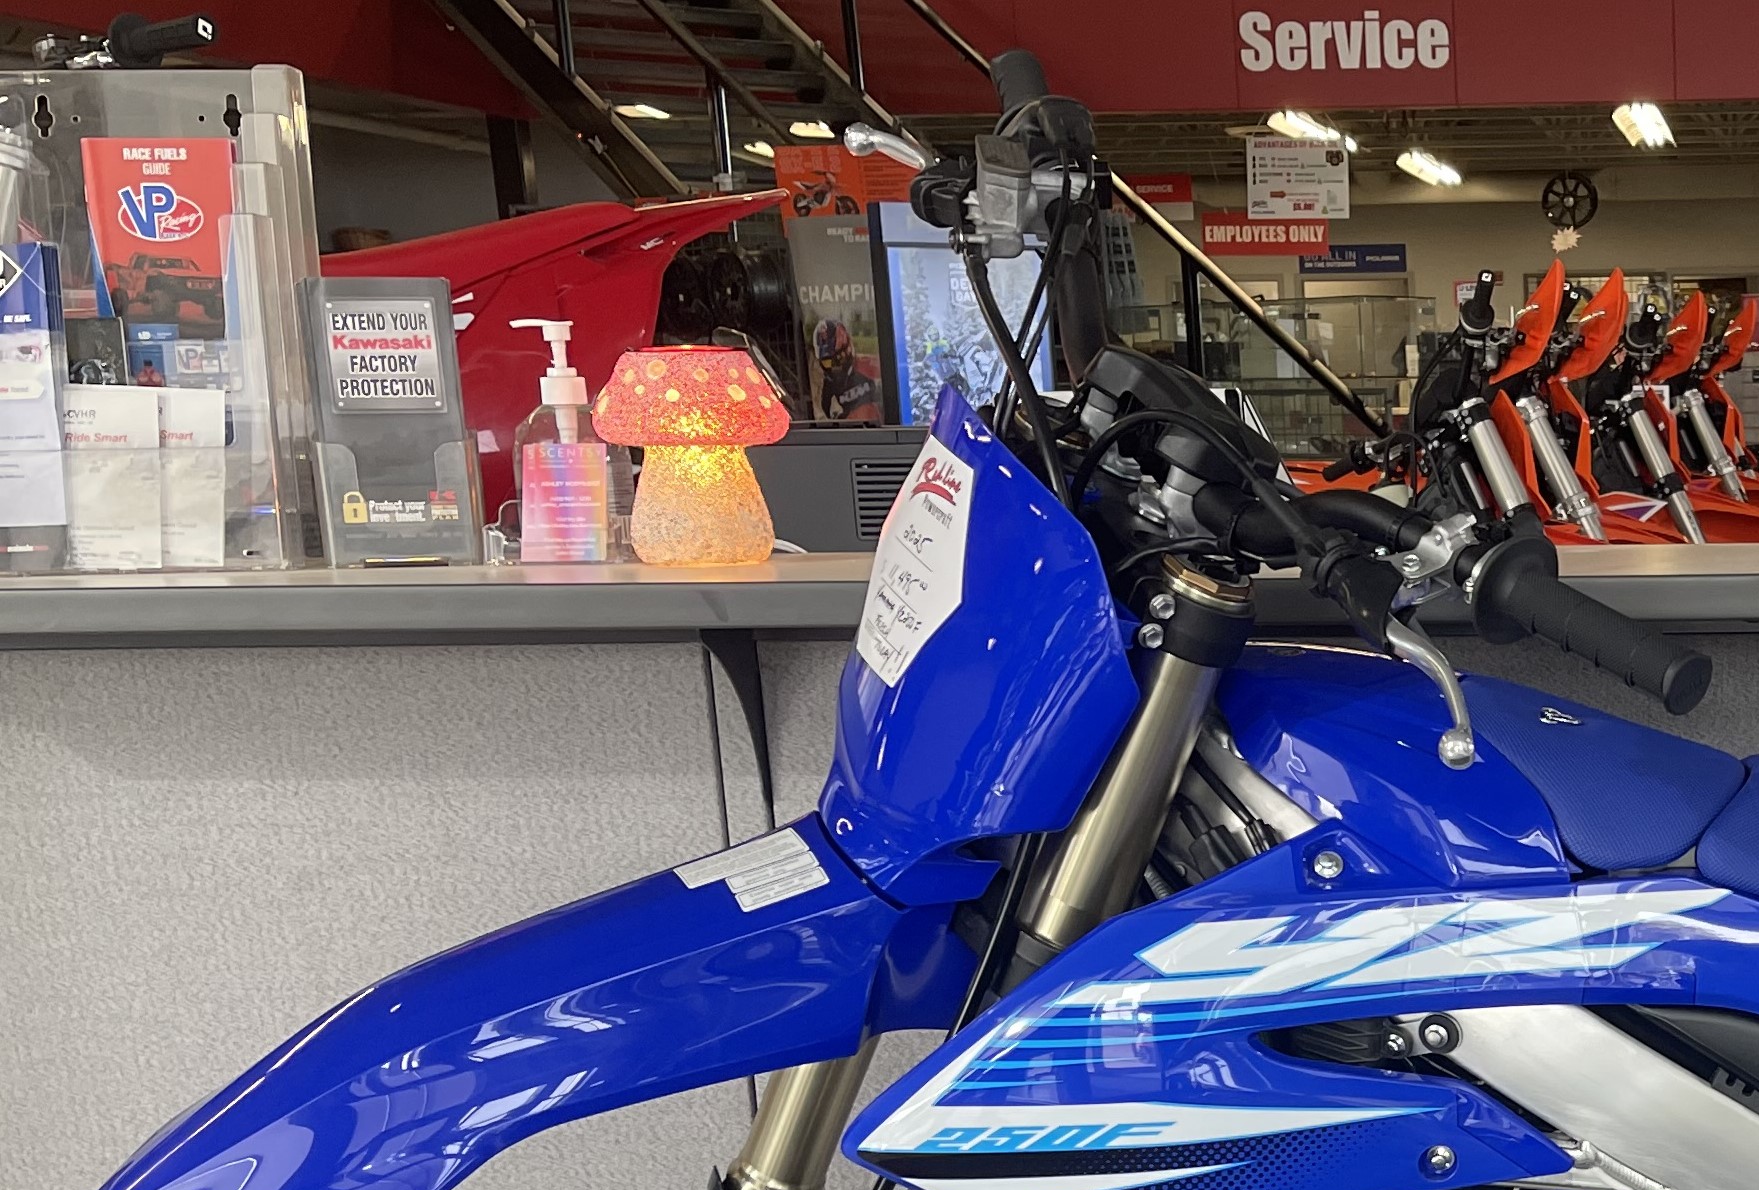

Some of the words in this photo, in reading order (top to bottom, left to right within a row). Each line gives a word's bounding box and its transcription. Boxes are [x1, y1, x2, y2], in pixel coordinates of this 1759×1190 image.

[1239, 10, 1451, 71] Service
[122, 148, 152, 161] RACE
[154, 148, 188, 161] FUELS
[142, 163, 172, 176] GUIDE
[1135, 184, 1174, 194] SERVICE
[117, 182, 177, 241] VP
[158, 212, 200, 234] Racing
[1205, 225, 1286, 243] EMPLOYEES
[1289, 225, 1325, 243] ONLY
[1321, 251, 1342, 261] ALL
[1343, 251, 1357, 261] IN
[800, 284, 874, 305] CHAMPI
[332, 313, 386, 331] EXTEND
[390, 313, 428, 331] YOUR
[332, 335, 432, 350] Kawasaki
[349, 355, 418, 373] FACTORY
[339, 378, 435, 397] PROTECTION
[65, 432, 91, 443] Ride
[94, 432, 128, 443] Smart
[160, 430, 194, 441] Smart
[369, 500, 403, 512] Protect
[903, 524, 934, 554] 2025
[1042, 888, 1735, 1007] YZ
[915, 1121, 1177, 1151] 250F
